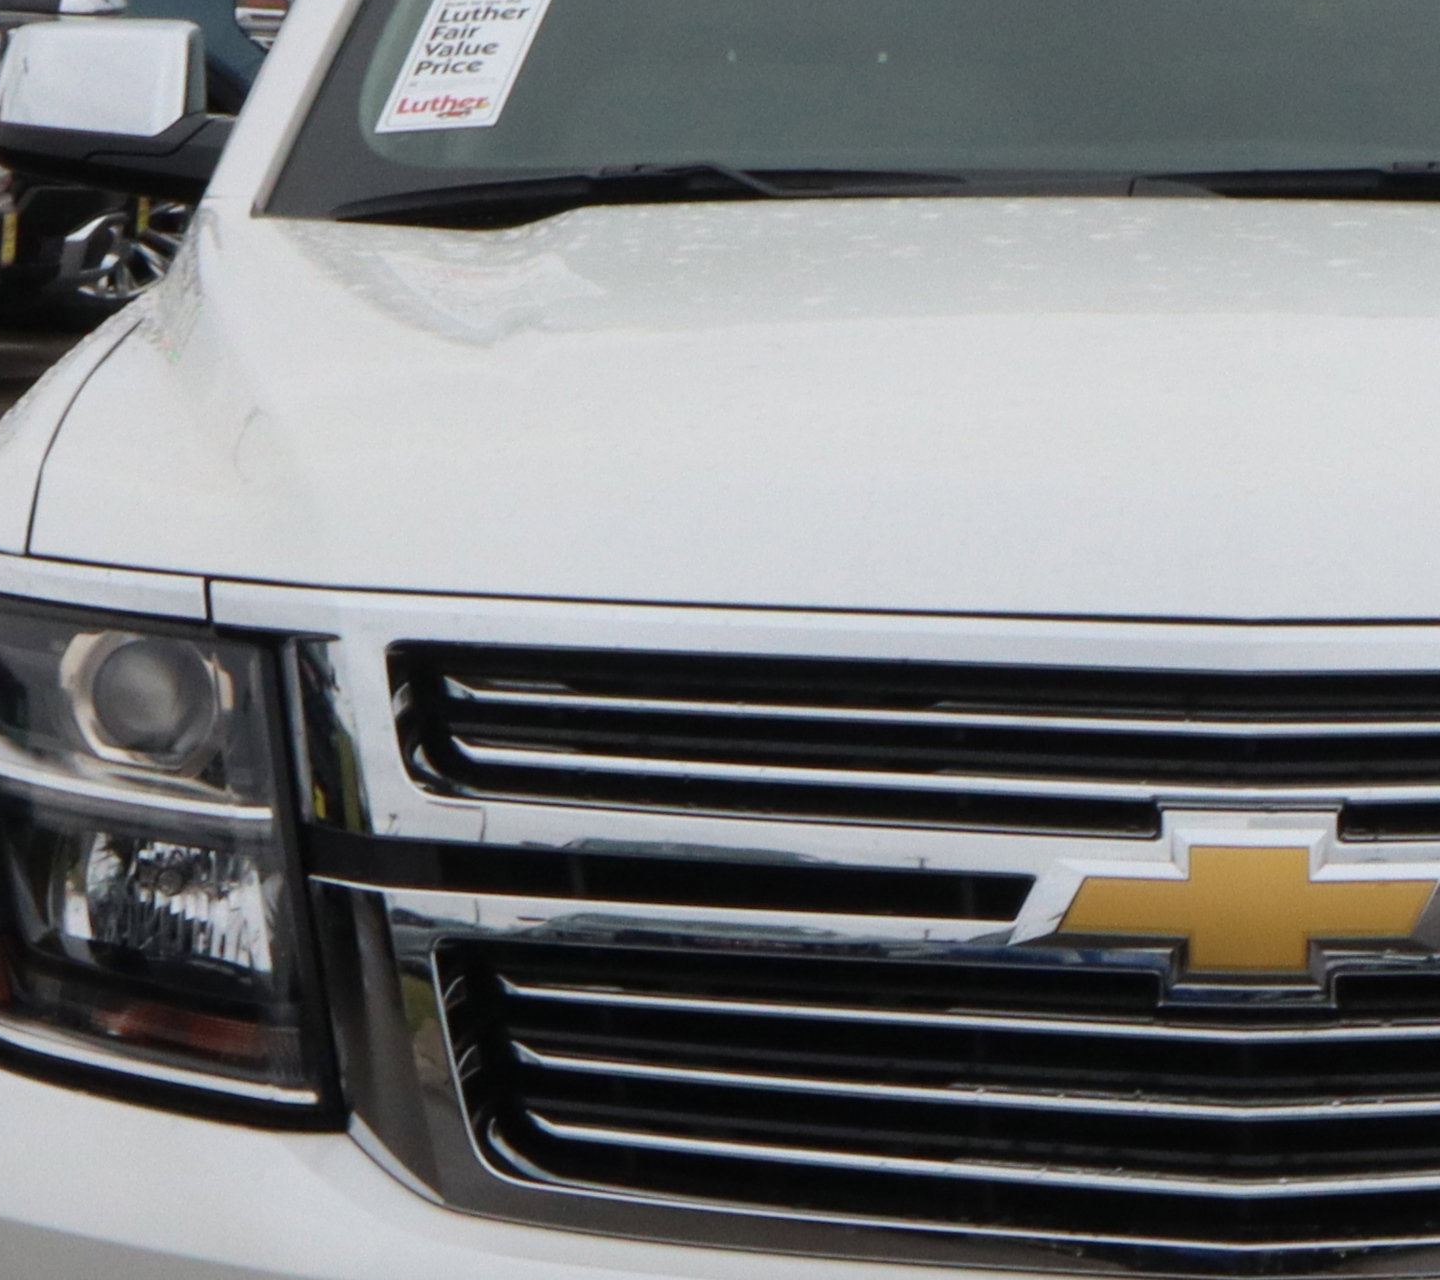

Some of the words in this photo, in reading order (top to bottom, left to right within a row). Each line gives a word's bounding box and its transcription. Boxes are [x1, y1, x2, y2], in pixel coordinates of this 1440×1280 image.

[438, 6, 530, 23] Luther
[430, 24, 480, 41] Fair
[424, 41, 499, 58] Value
[413, 58, 484, 76] Price
[396, 95, 489, 115] Luther
